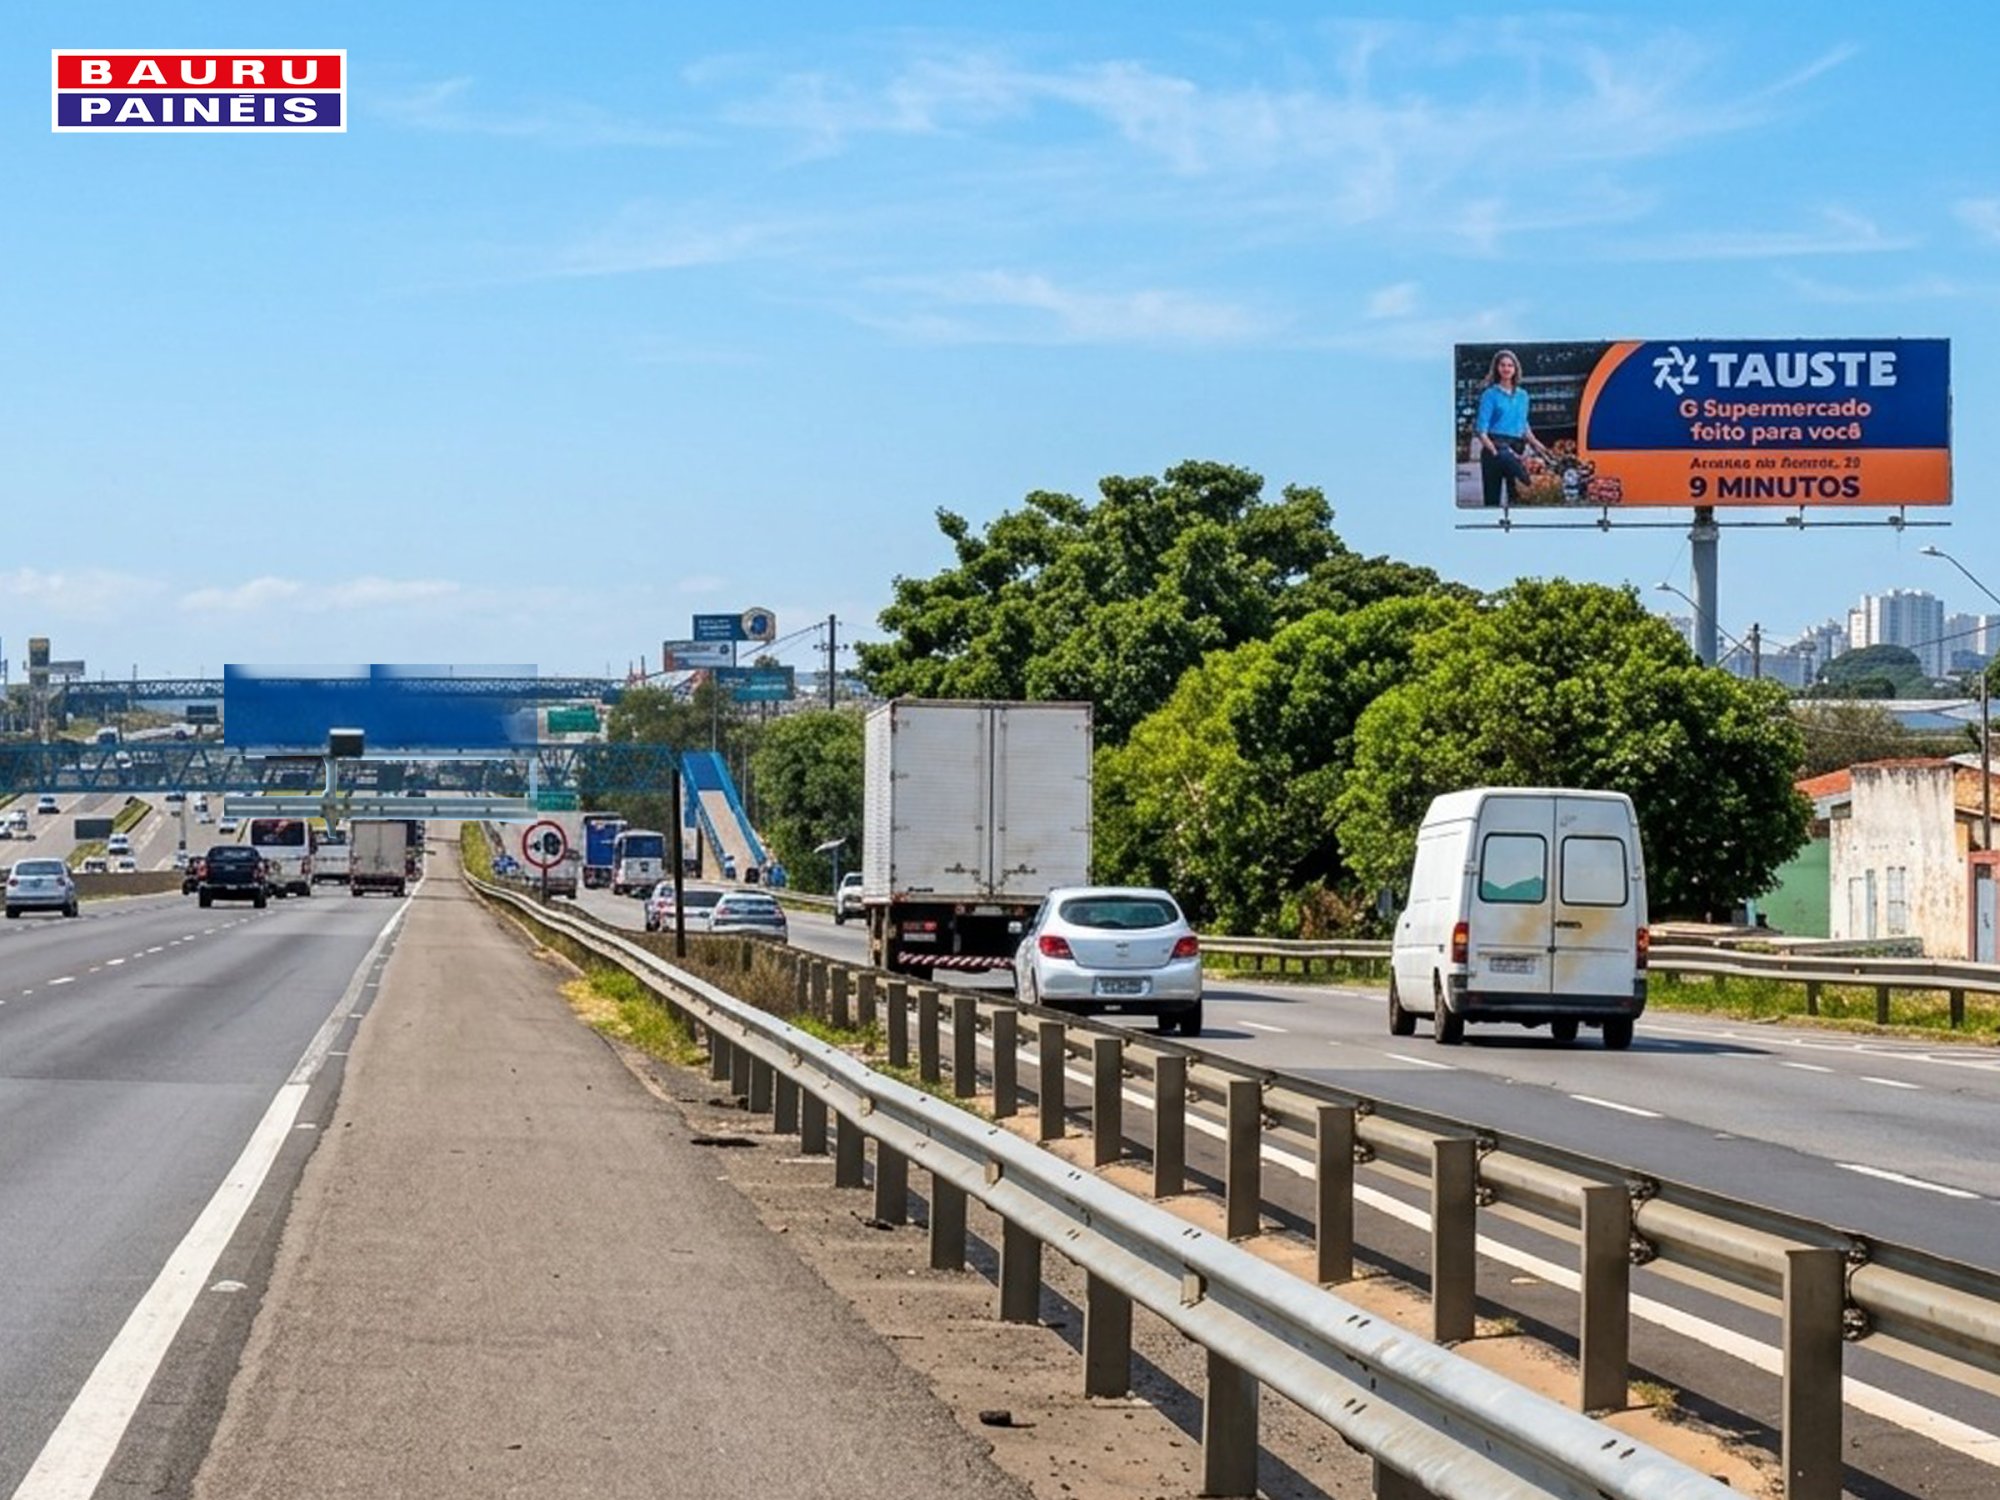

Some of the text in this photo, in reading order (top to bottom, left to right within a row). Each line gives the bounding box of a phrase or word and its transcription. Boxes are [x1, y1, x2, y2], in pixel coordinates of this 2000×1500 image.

[1708, 352, 1897, 387] TAUSTE
[1703, 399, 1871, 421] Supermercado
[1751, 426, 1802, 445] para
[1689, 476, 1861, 498] 9 MINUTOS
